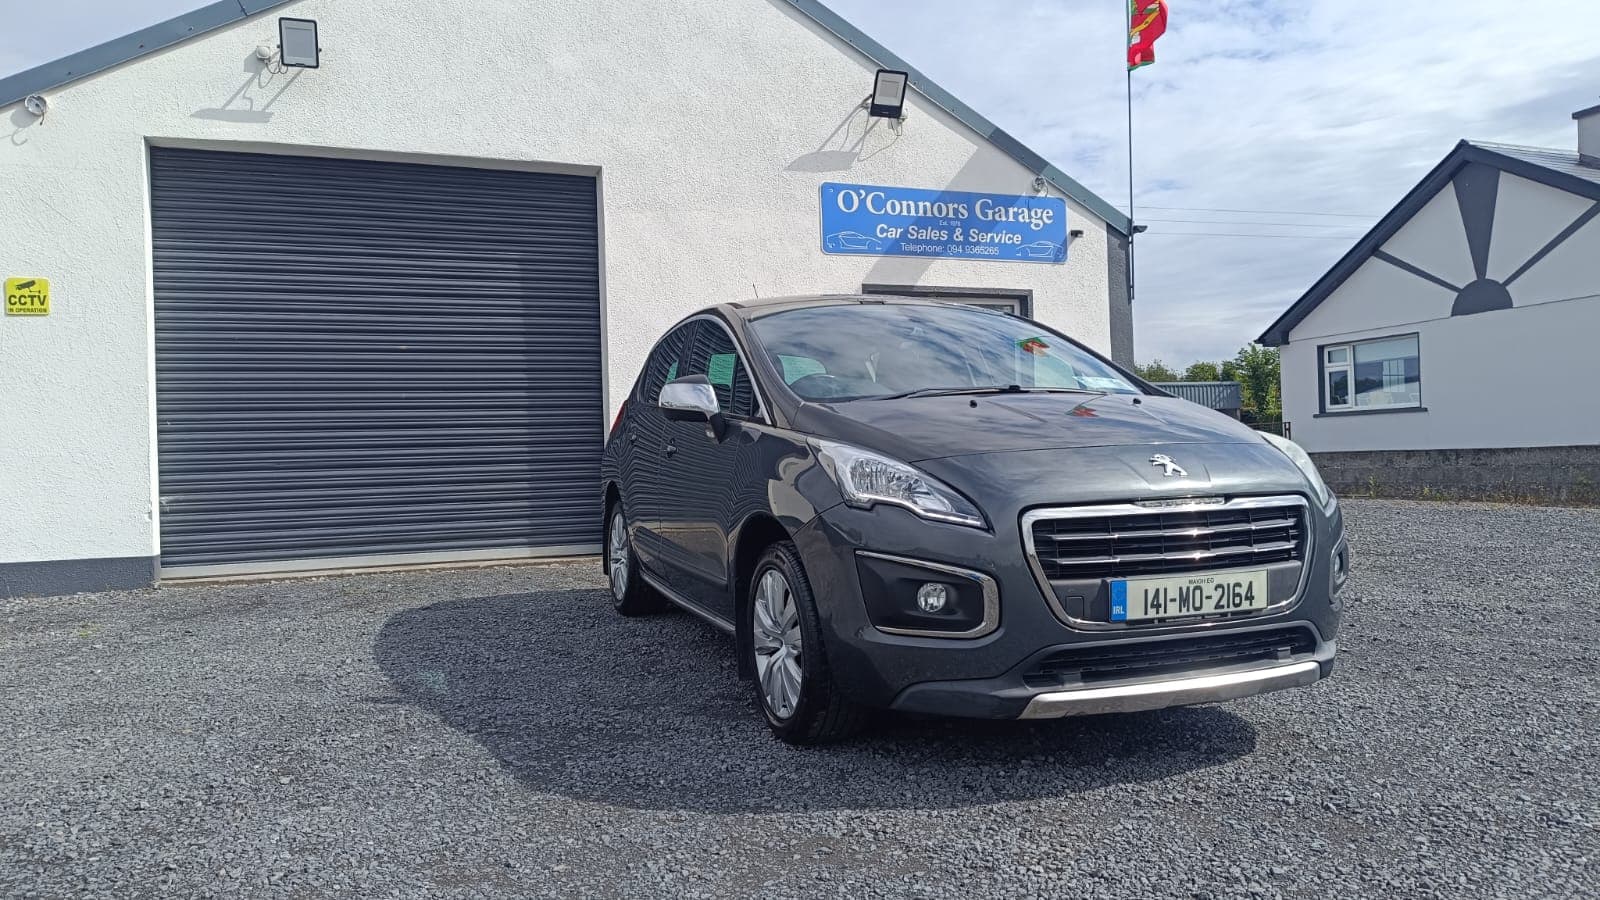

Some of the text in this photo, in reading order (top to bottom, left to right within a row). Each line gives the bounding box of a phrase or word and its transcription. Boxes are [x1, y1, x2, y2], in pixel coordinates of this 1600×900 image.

[837, 189, 1054, 231] O'Connors Garage
[876, 224, 1022, 245] Car Sales & Service
[900, 242, 945, 254] Telephone:
[947, 244, 962, 254] 094
[8, 294, 47, 306] CCTV
[1143, 580, 1255, 616] 141-MO-2164
[1112, 605, 1125, 615] IRL
